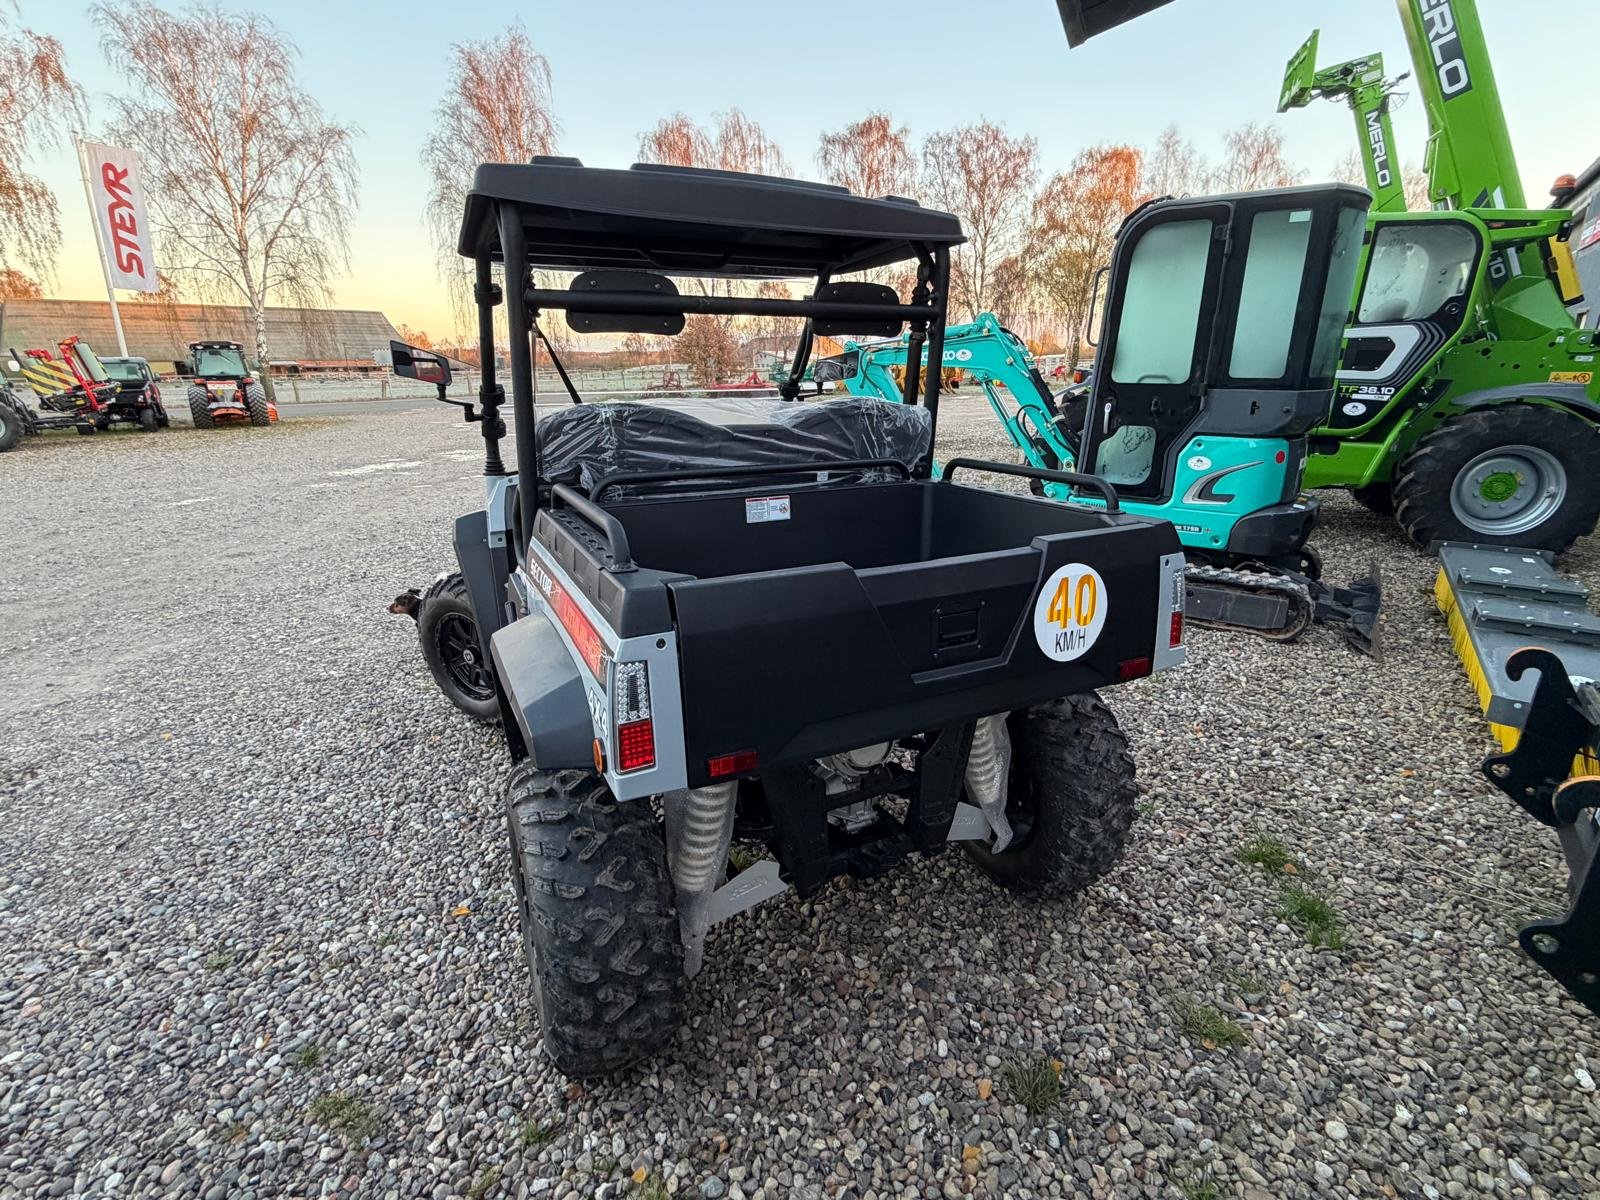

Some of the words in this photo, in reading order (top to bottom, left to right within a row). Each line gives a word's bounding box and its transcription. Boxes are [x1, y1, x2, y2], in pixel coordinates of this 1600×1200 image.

[1365, 110, 1391, 187] MERLO
[102, 162, 145, 279] STEYR
[530, 558, 553, 594] SECTOR
[1047, 573, 1098, 629] 40
[1054, 628, 1087, 653] KM/H
